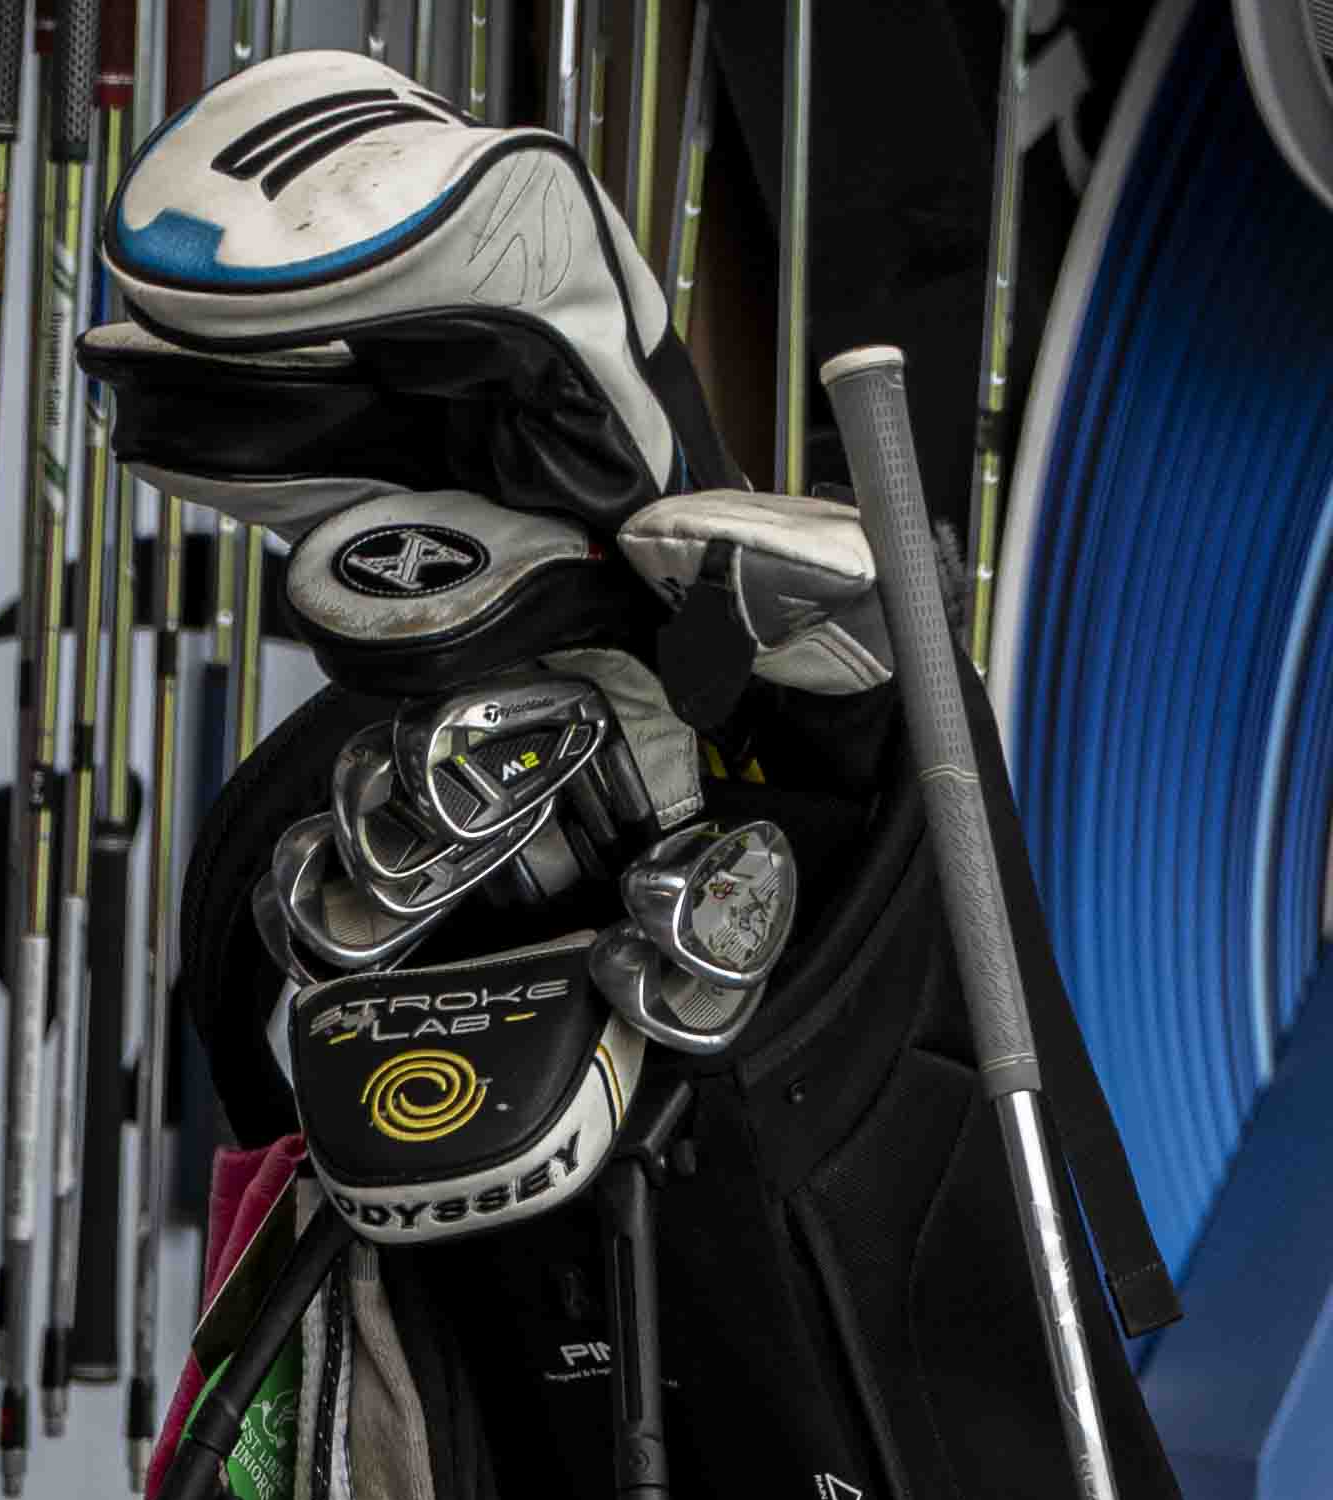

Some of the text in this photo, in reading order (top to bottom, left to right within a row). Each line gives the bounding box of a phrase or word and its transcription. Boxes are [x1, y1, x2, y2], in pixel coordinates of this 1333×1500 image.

[500, 750, 541, 783] M2
[308, 978, 570, 1038] STROKE
[370, 1012, 491, 1042] LAB
[813, 1474, 829, 1500] RAIN
